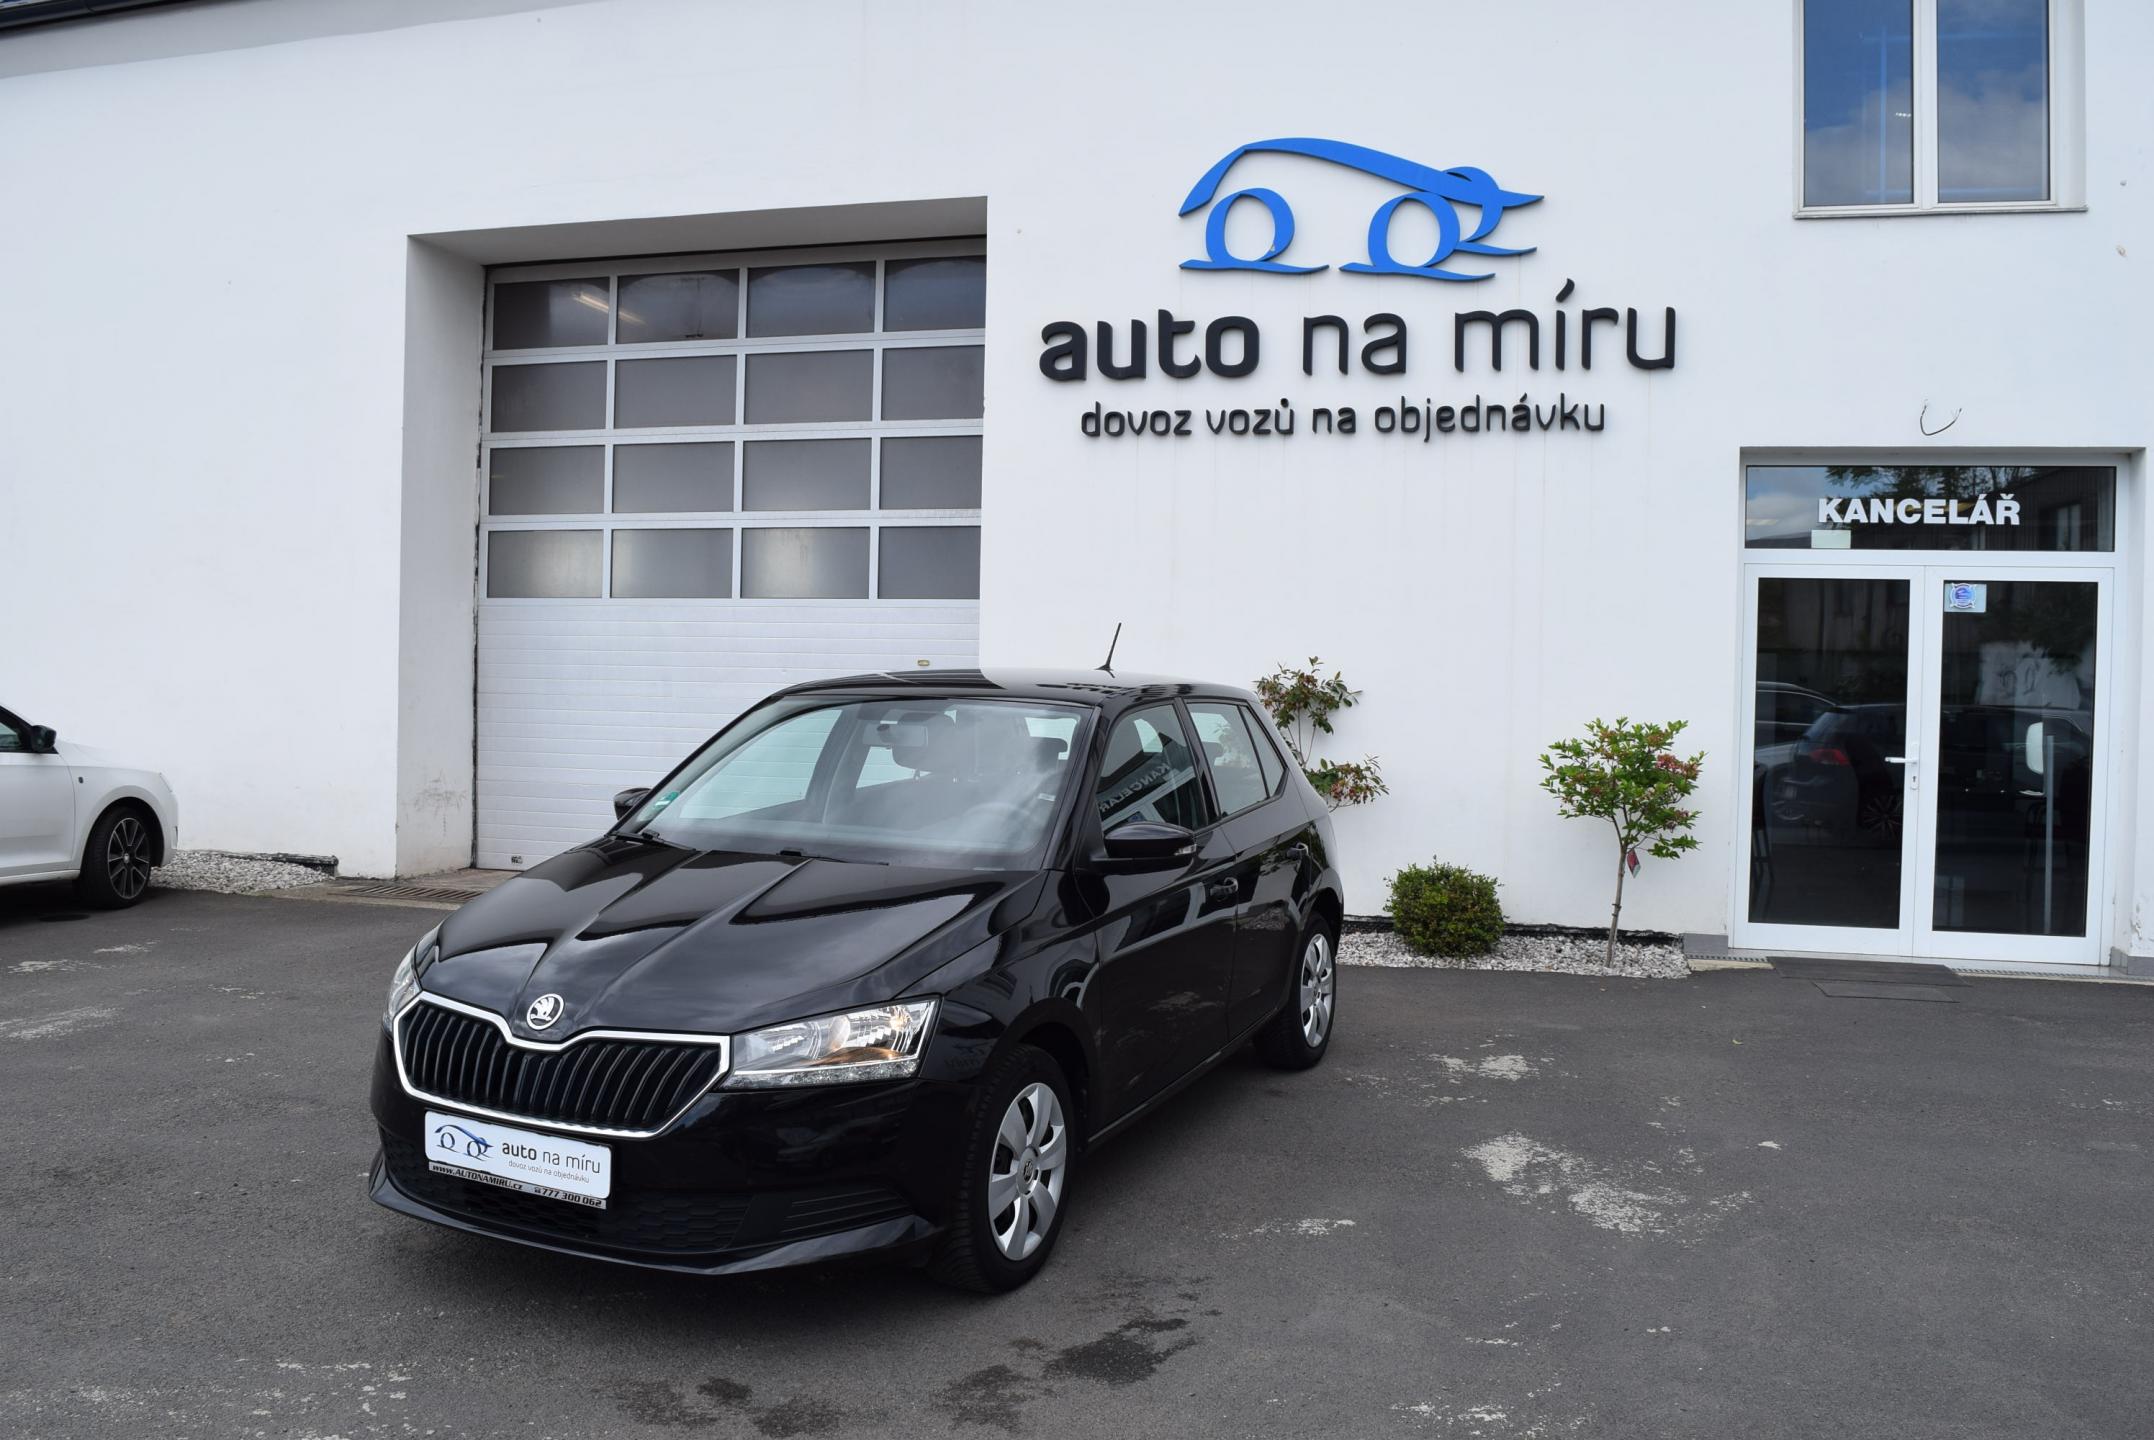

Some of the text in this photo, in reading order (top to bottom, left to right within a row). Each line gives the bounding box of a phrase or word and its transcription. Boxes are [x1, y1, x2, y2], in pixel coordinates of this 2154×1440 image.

[1039, 278, 1676, 383] auto na míru
[1080, 392, 1605, 444] dovoz vozů na objednávku
[1818, 493, 2021, 525] KANCELÁŘ
[502, 1142, 601, 1174] auto na míru
[508, 1160, 527, 1170] dovoz
[553, 1169, 590, 1183] objednávku
[561, 1192, 581, 1203] 300
[582, 1197, 602, 1207] 062
